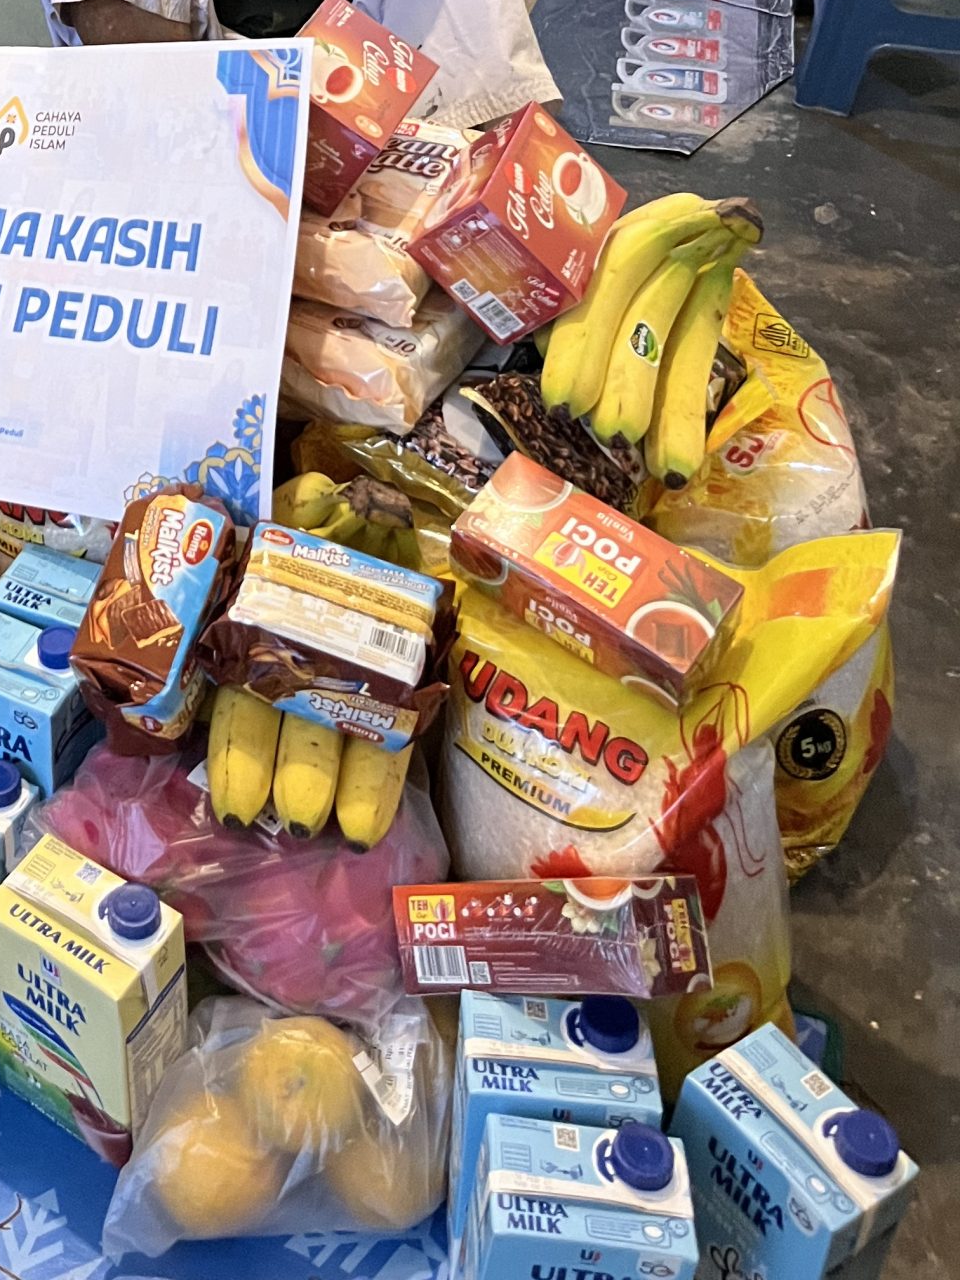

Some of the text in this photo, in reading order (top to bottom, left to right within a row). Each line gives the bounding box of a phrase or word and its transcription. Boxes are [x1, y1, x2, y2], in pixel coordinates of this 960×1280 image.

[32, 125, 75, 136] PEDULI
[36, 111, 81, 122] CAHAYA
[29, 138, 66, 150] ISLAM
[387, 138, 459, 159] eam
[371, 153, 446, 177] atte
[45, 213, 203, 272] KASIH
[13, 287, 219, 356] PEDULI
[394, 339, 416, 353] 10
[0, 427, 24, 438] Peduli
[150, 508, 185, 586] Malkist
[186, 524, 208, 560] Roma
[292, 542, 352, 568] Malkist
[559, 516, 642, 576] POCI
[2, 591, 43, 611] MILK
[3, 580, 53, 606] ULTRA
[582, 571, 619, 603] TEH
[529, 598, 593, 648] POCI
[309, 692, 395, 730] Malkist
[460, 649, 648, 786] UDANG
[800, 736, 816, 759] 5
[481, 751, 572, 815] PREMIUM
[410, 899, 428, 911] TEH
[8, 903, 112, 975] ULTRA MILK
[413, 923, 456, 939] POCI
[17, 963, 87, 1024] ULTRA
[26, 986, 80, 1037] MILK
[472, 1058, 540, 1080] ULTRA
[481, 1075, 534, 1093] MILK
[708, 1061, 763, 1119] ULTRA
[700, 1077, 751, 1121] MILK
[708, 1136, 785, 1231] ULTRA
[498, 1194, 569, 1219] ULTRA
[710, 1164, 772, 1237] MILK
[507, 1213, 563, 1234] MILK
